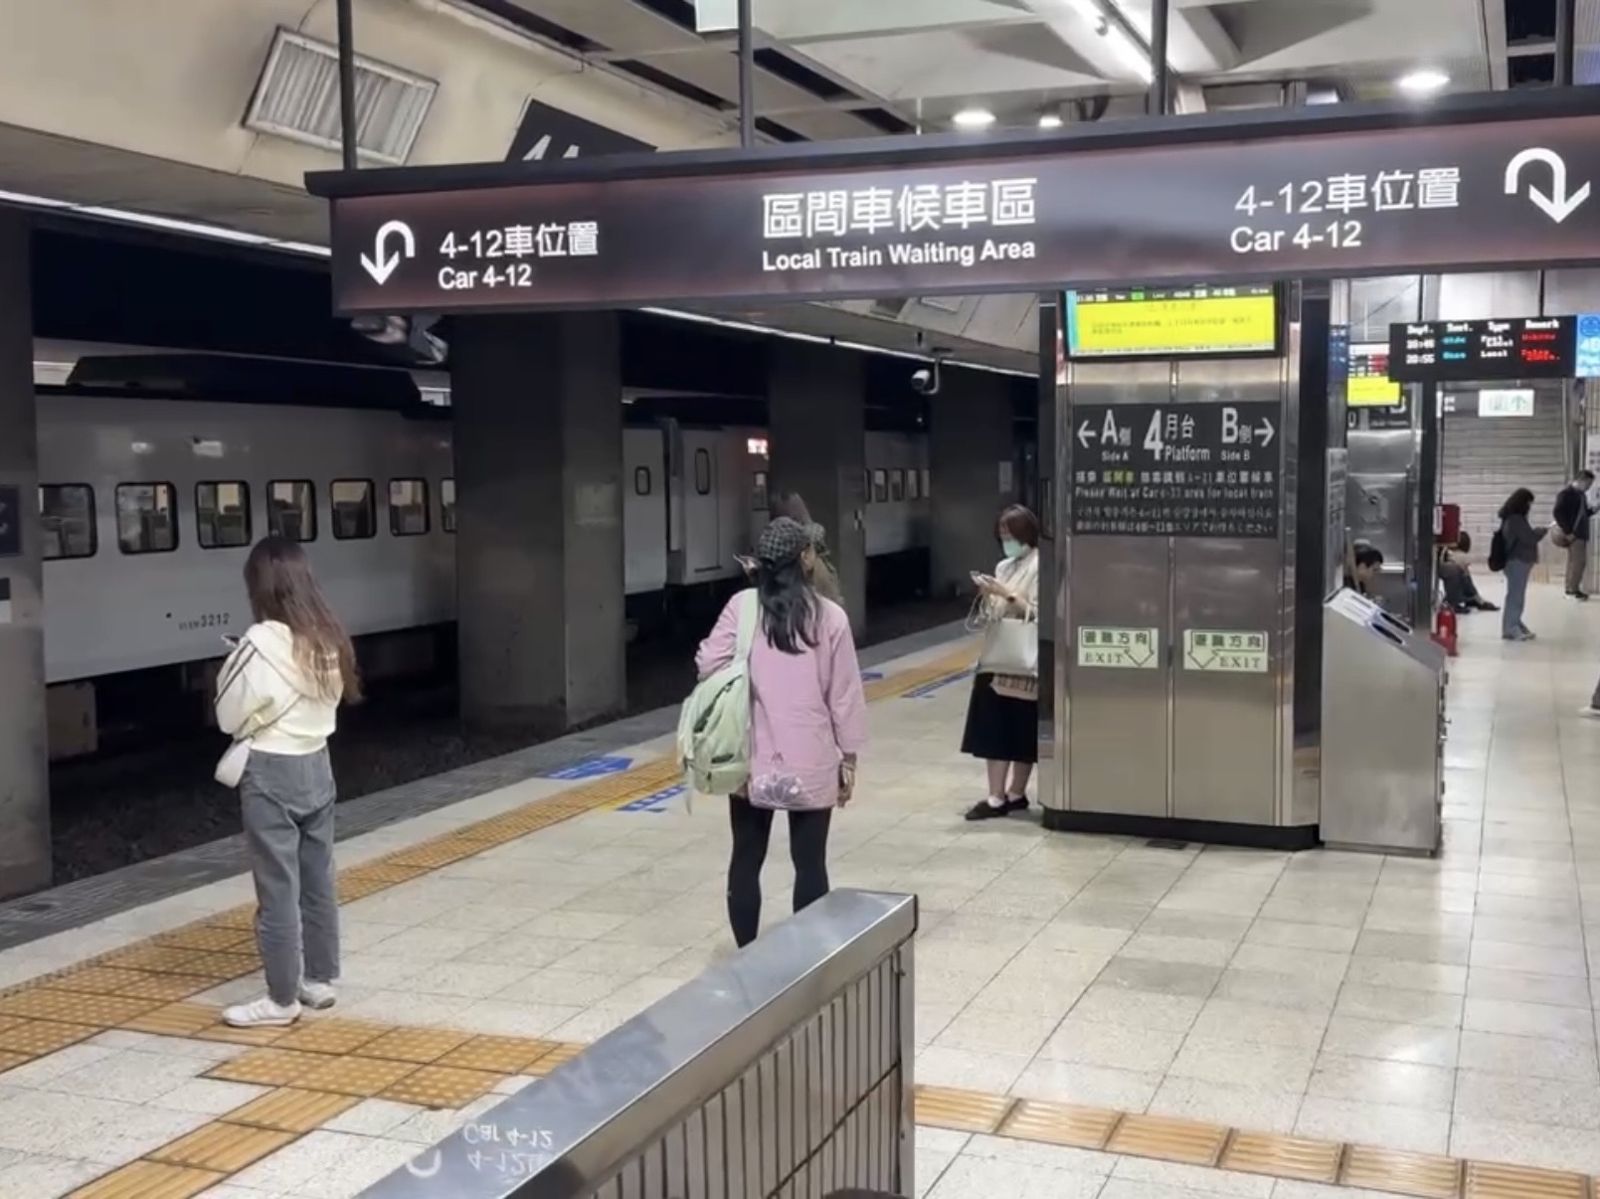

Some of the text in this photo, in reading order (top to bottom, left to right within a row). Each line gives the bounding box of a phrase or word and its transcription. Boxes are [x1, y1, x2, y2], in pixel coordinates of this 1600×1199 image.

[1234, 167, 1461, 217] 4-12車位置
[763, 178, 1037, 238] 區間車候車區
[440, 221, 598, 258] 4-12車位置
[1230, 220, 1362, 253] Car 4-12
[762, 239, 1036, 271] Local Train Waiting Area
[438, 263, 532, 290] Car 4-12
[1143, 409, 1164, 461] 4
[1165, 413, 1196, 440] 月台
[1101, 450, 1129, 461] Side A
[1164, 445, 1211, 462] Platform
[1221, 449, 1250, 461] Side B
[1084, 652, 1123, 664] EXIT
[1219, 656, 1261, 669] EXIT
